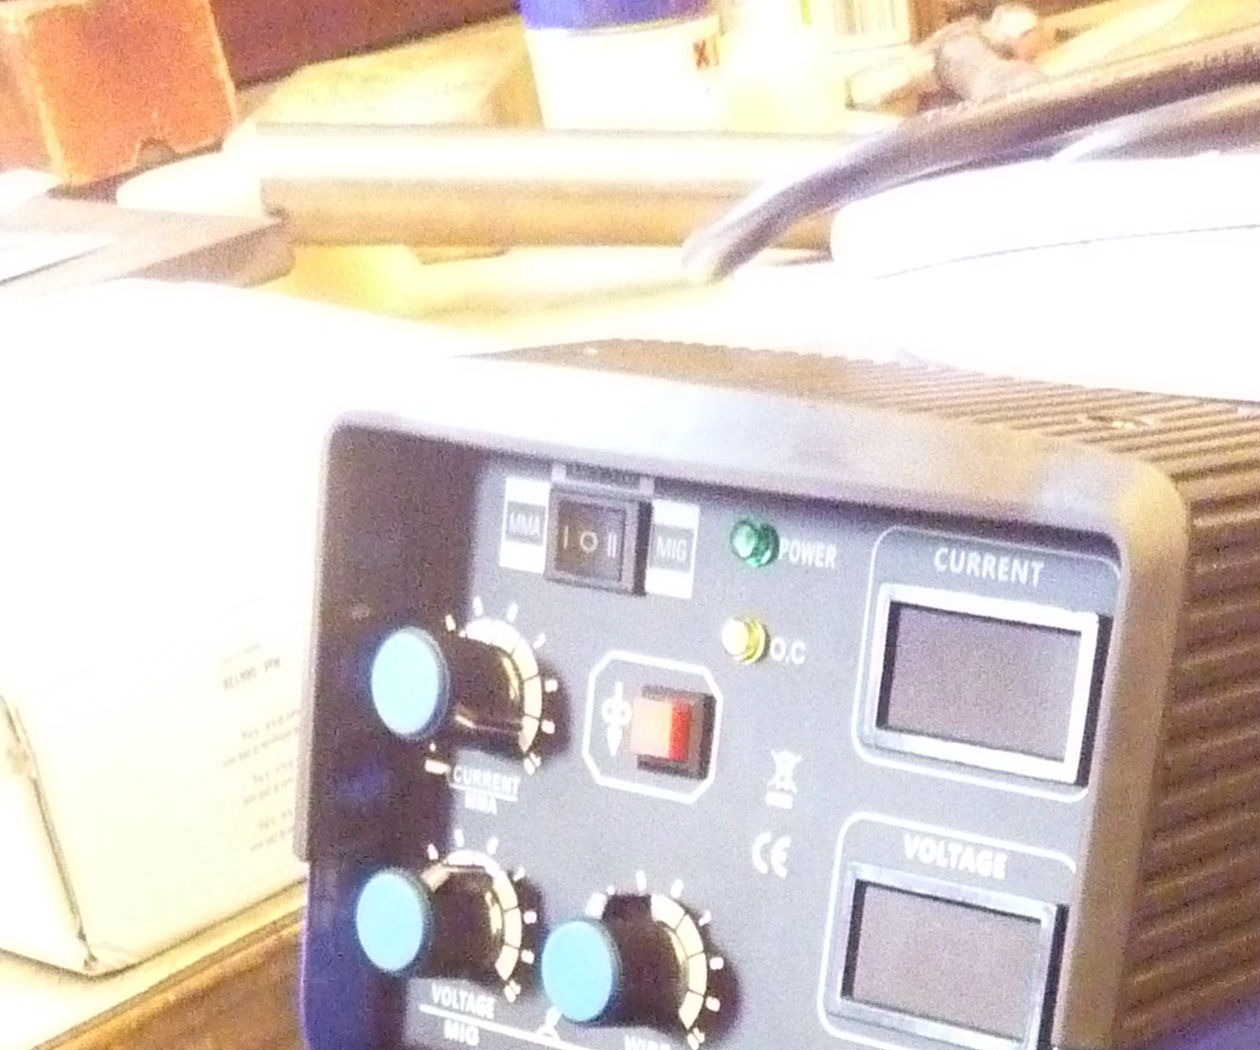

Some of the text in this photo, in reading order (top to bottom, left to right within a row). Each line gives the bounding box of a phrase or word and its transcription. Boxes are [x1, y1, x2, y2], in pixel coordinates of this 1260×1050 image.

[507, 511, 543, 537] MMA
[656, 535, 688, 562] MIG
[779, 538, 837, 568] POWER
[934, 547, 1045, 587] CURRENT
[768, 636, 807, 665] O.C
[453, 764, 521, 796] CURRENT
[903, 832, 1009, 880] VOLTAGE
[431, 983, 497, 1020] VOLTAGE
[443, 1018, 480, 1047] MIG
